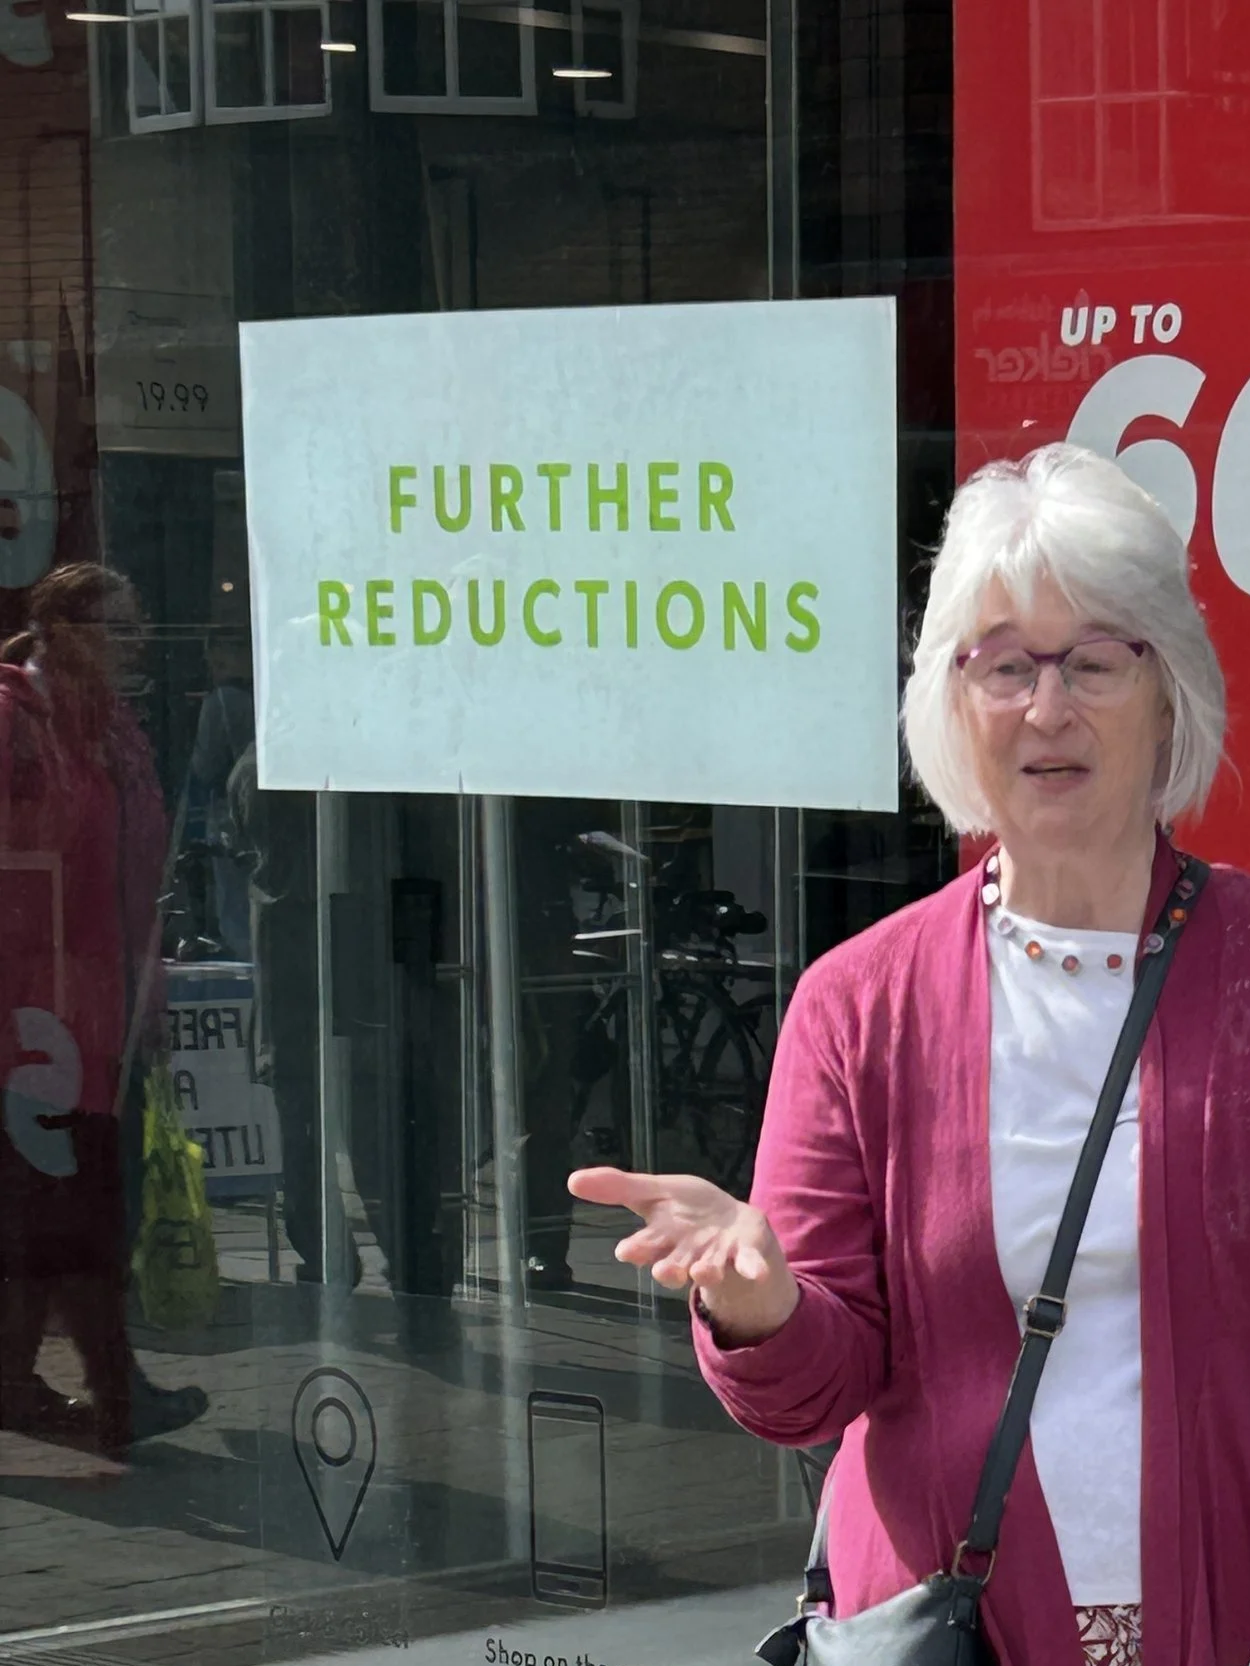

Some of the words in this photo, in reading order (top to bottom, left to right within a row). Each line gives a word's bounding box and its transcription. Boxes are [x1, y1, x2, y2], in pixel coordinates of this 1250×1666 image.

[1060, 305, 1117, 347] UP
[1131, 302, 1182, 344] TO
[389, 461, 736, 535] FURTHER
[317, 579, 822, 653] REDUCTIONS
